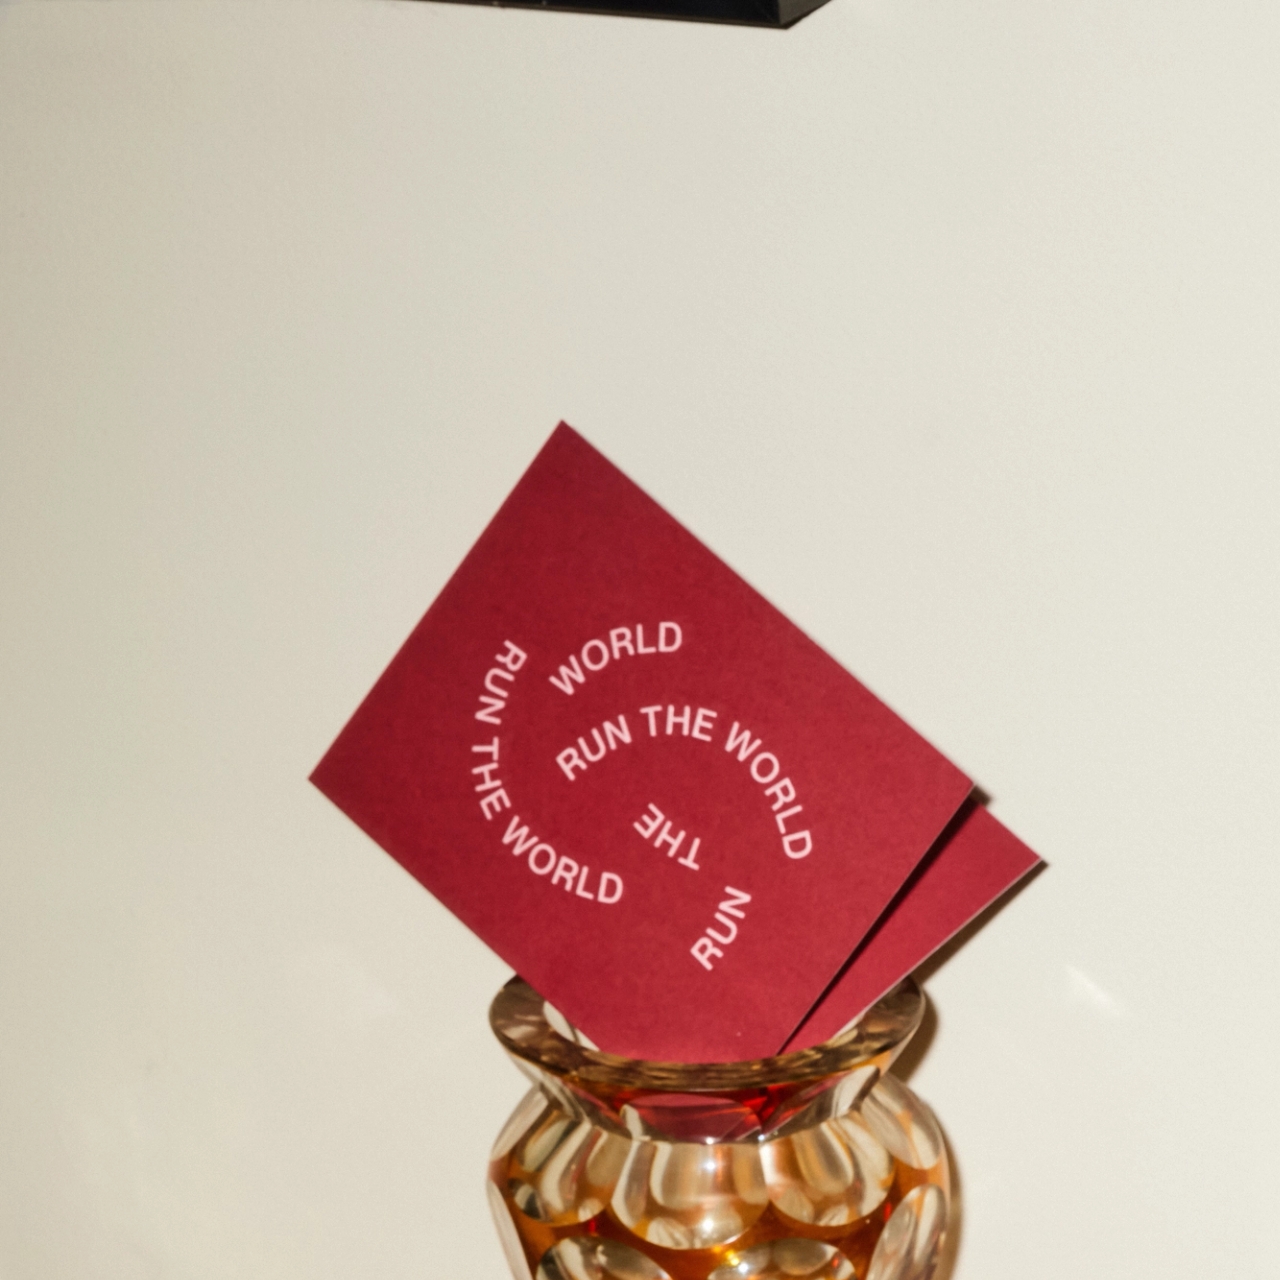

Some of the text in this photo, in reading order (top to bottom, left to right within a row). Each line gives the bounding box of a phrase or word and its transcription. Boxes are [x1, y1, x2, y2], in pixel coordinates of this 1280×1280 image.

[549, 621, 683, 695] WORLD
[471, 640, 624, 904] RUN THE WORLD
[556, 704, 813, 860] RUN THE WORLD
[633, 803, 752, 971] RUN THE
